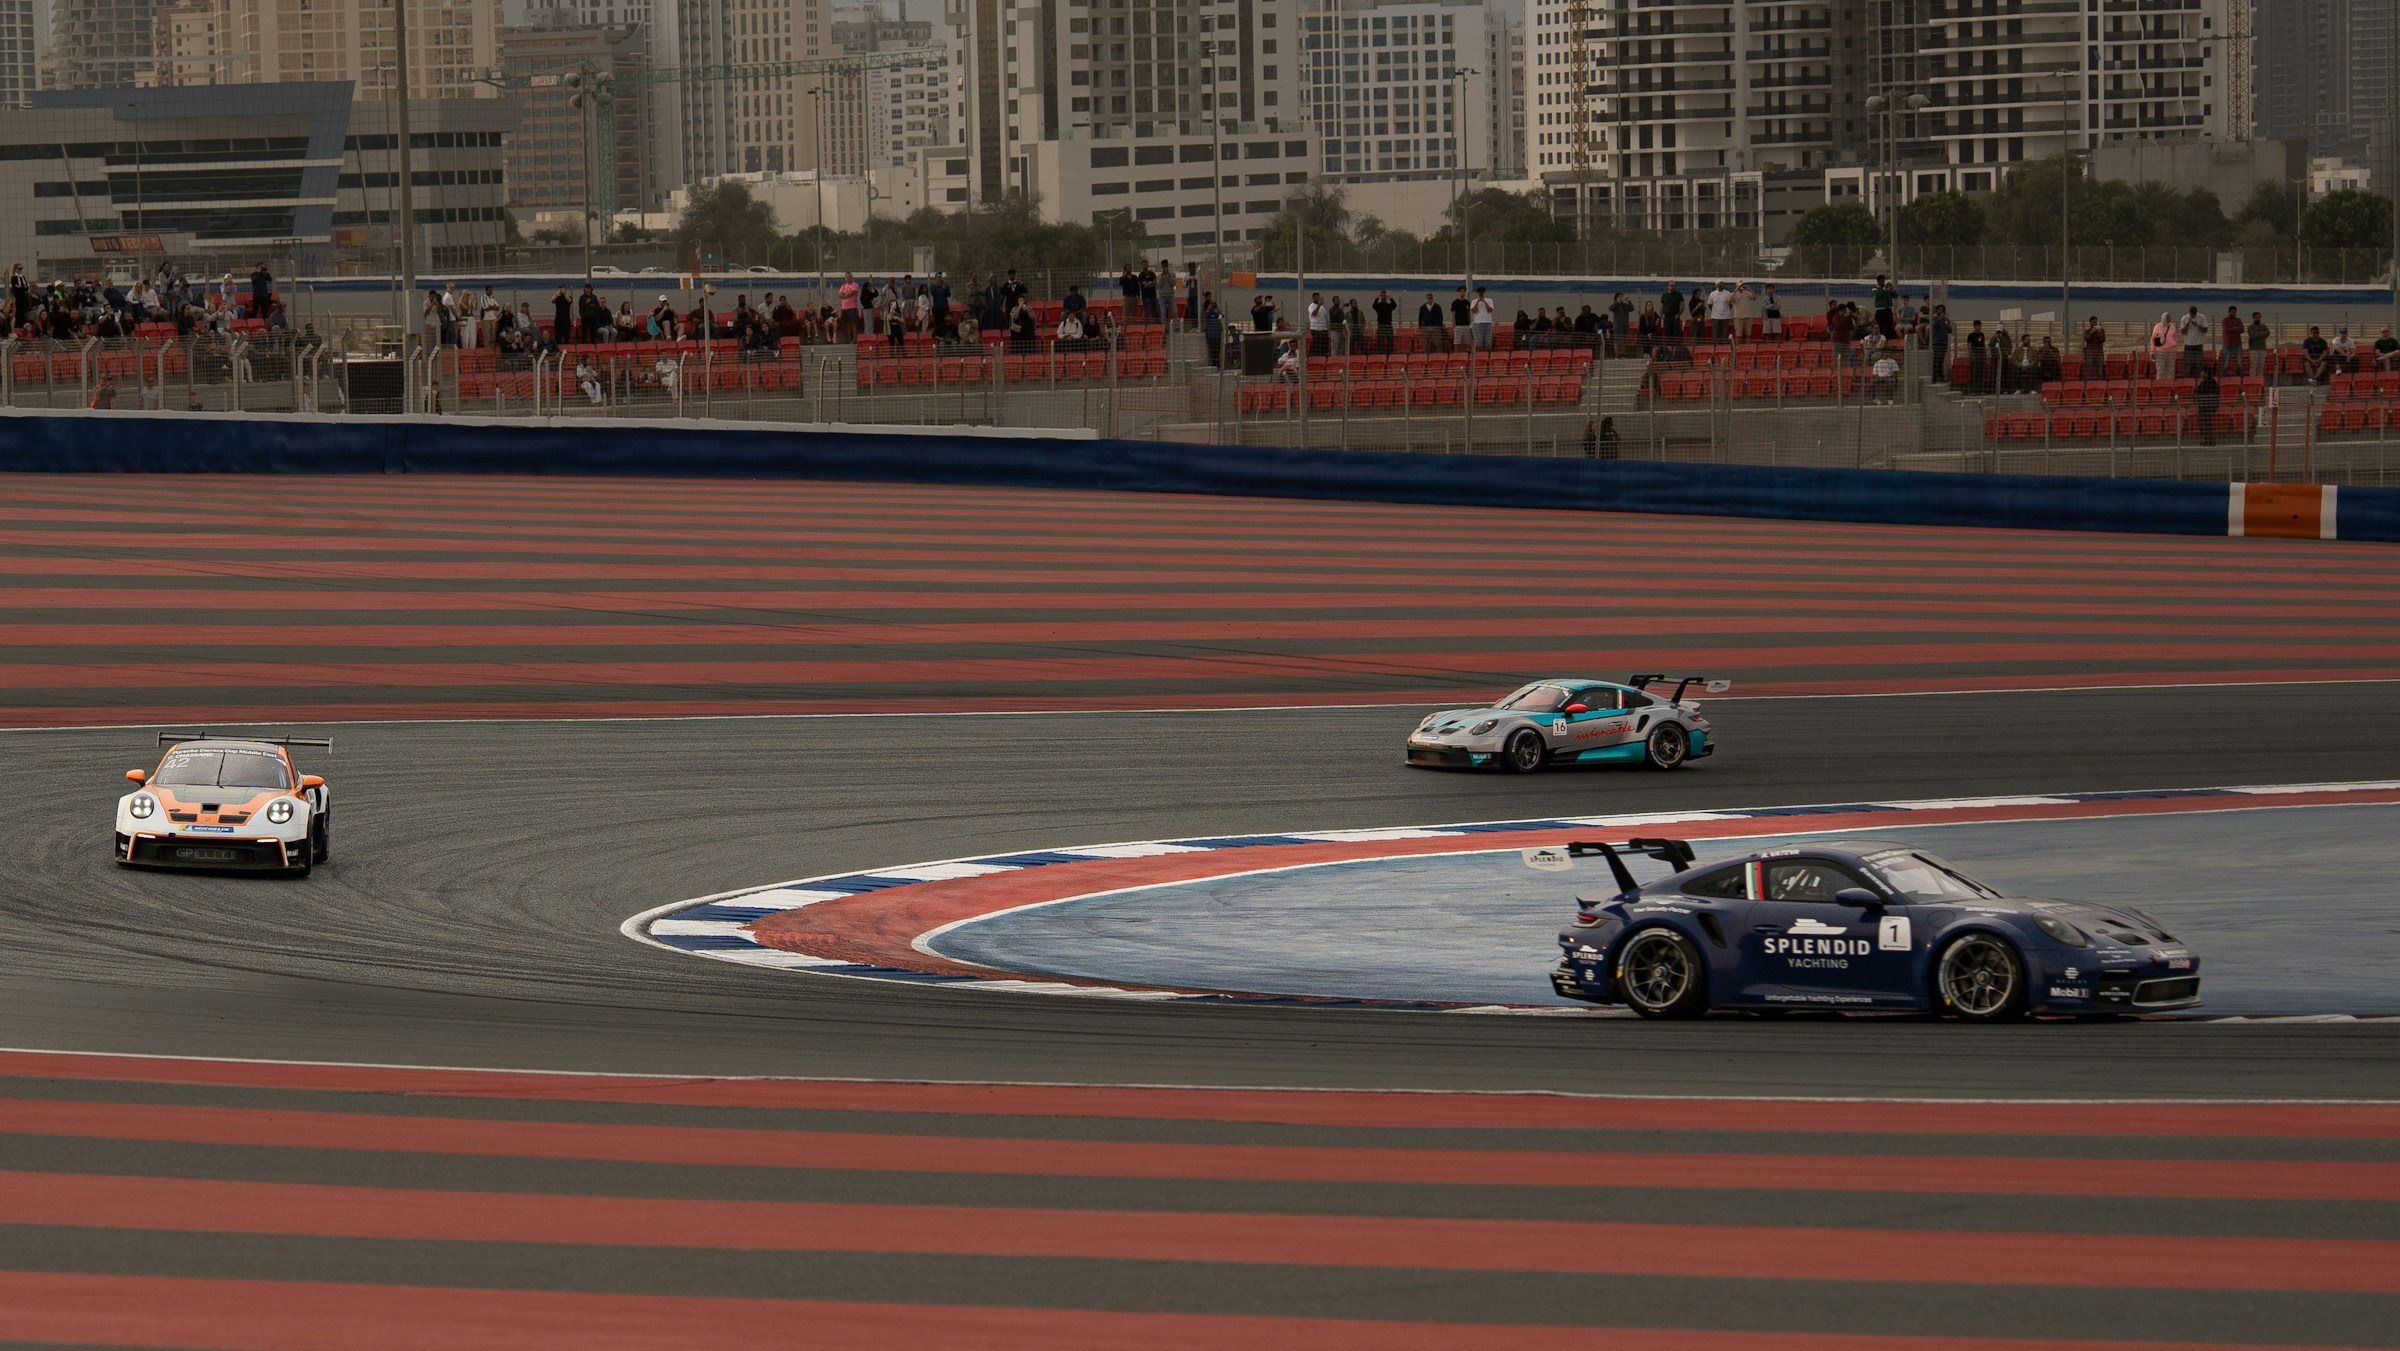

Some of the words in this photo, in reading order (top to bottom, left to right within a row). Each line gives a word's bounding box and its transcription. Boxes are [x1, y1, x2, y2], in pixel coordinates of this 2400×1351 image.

[1555, 722, 1566, 732] 16
[163, 757, 190, 768] 42
[1529, 855, 1564, 863] SPLENDID
[1889, 924, 1898, 943] 1
[1764, 938, 1871, 955] SPLENDID
[1787, 958, 1849, 969] YACHTING
